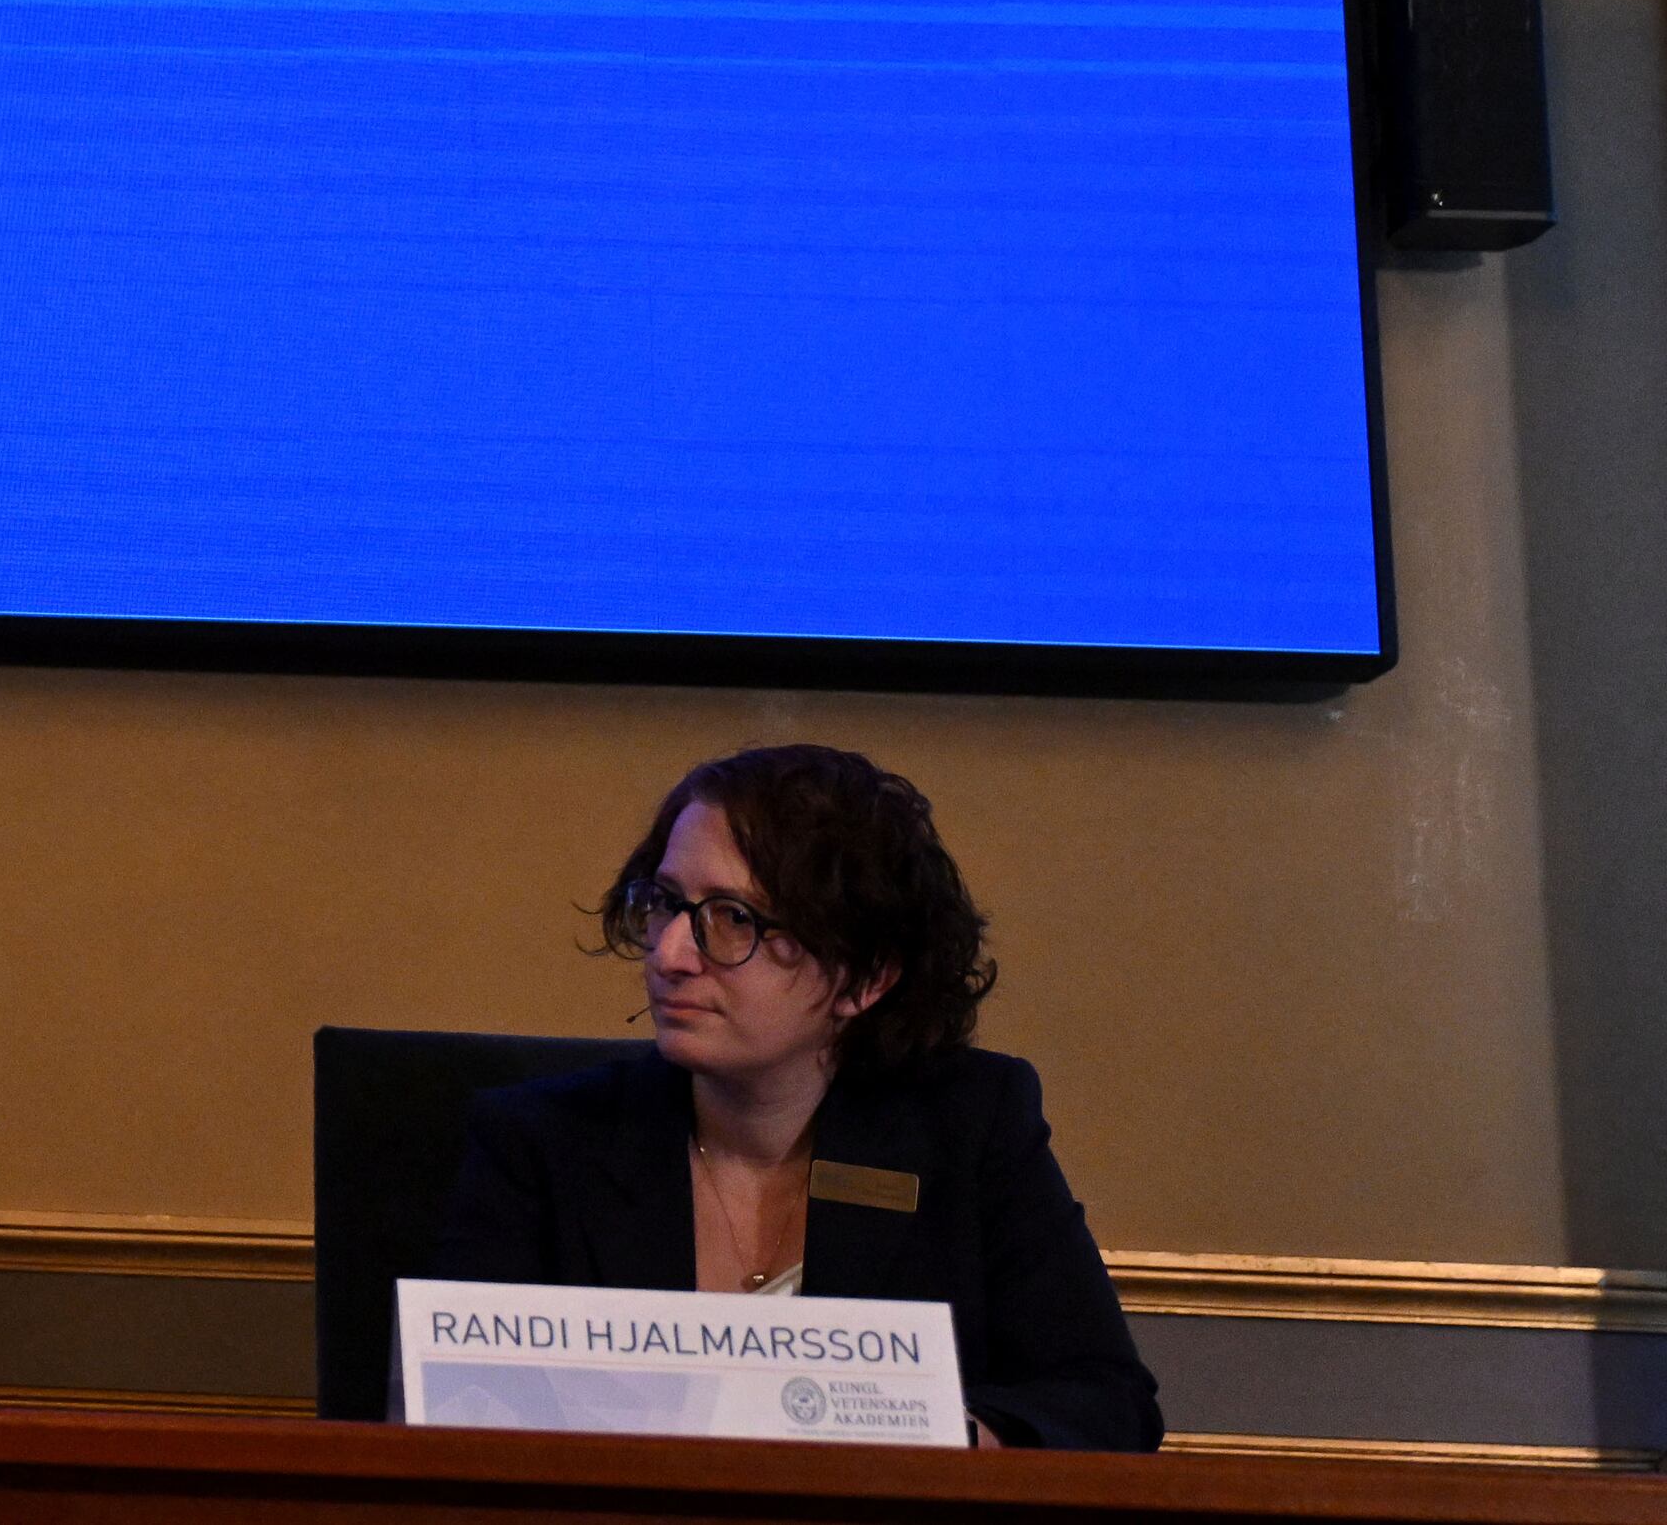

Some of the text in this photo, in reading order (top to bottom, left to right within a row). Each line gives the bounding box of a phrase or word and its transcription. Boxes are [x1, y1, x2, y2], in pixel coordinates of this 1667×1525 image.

[432, 1311, 920, 1365] RANDI HJALMARSSON
[834, 1413, 930, 1427] AKADEMIEN
